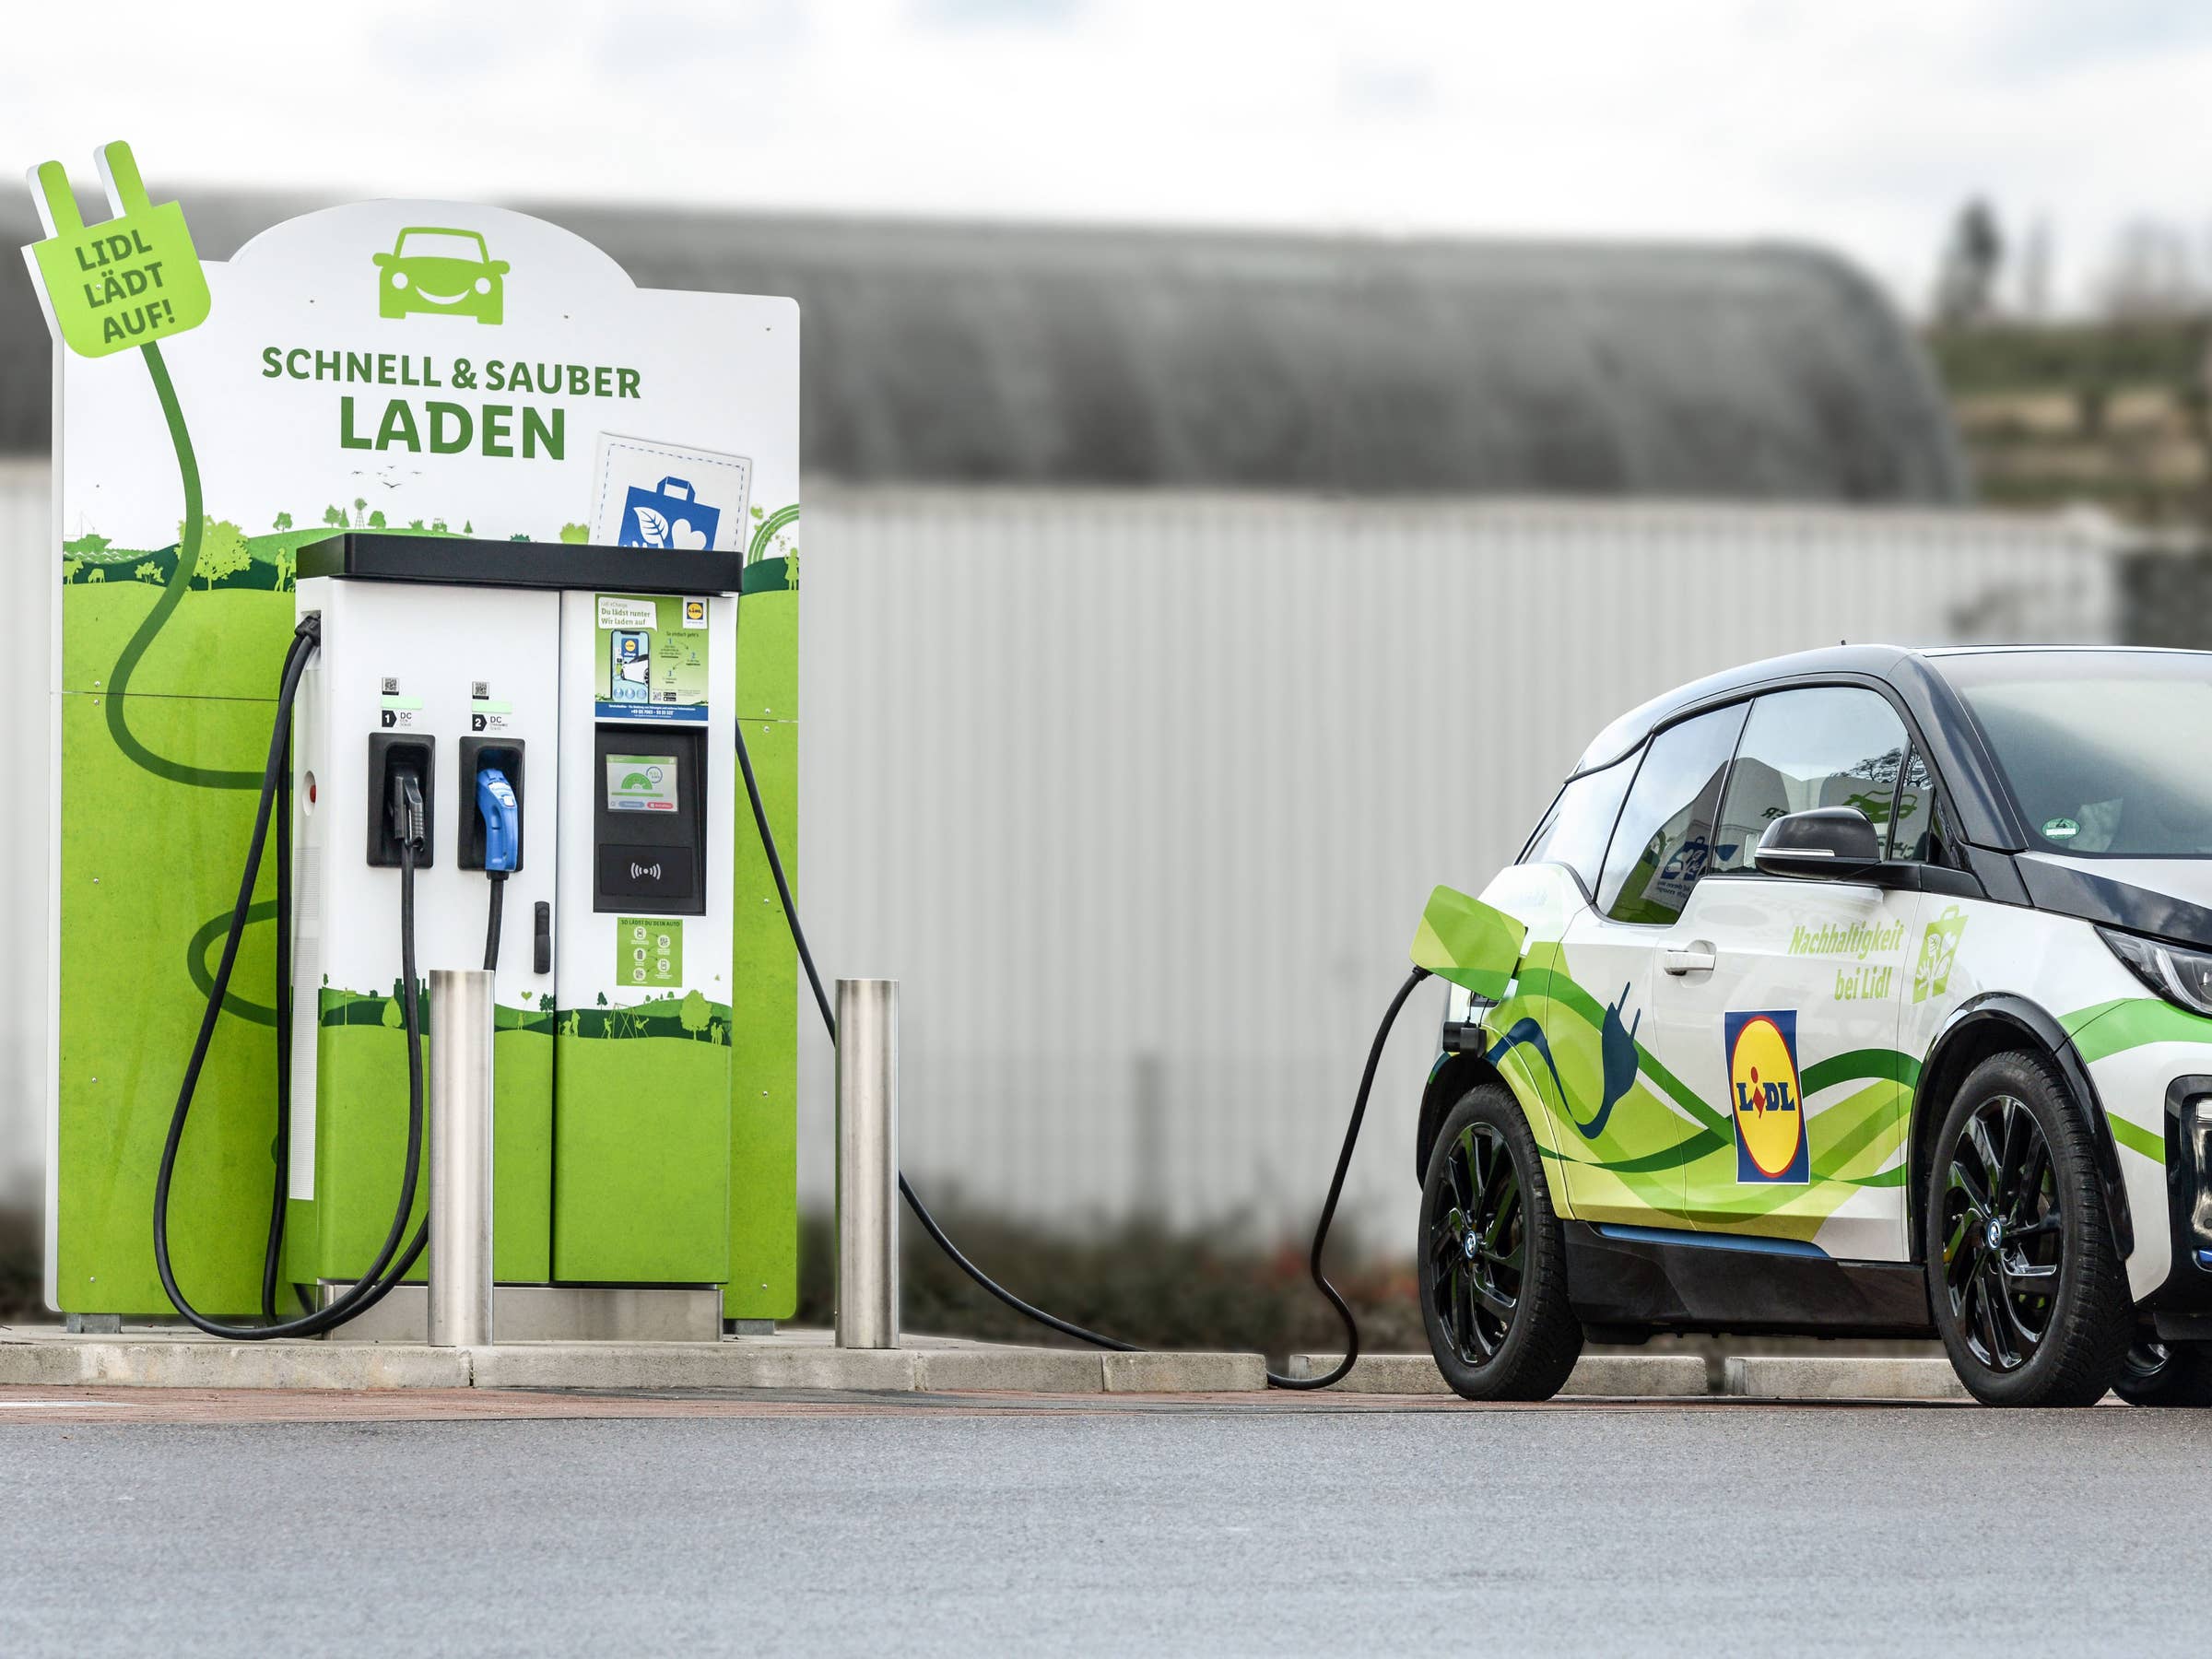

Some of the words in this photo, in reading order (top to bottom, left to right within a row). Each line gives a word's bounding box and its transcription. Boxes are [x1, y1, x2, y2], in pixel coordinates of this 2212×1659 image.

[75, 229, 153, 272] LIDL
[83, 261, 164, 309] LÄDT
[103, 299, 175, 344] AUF!
[262, 346, 442, 388] SCHNELL
[451, 357, 477, 390] &
[485, 359, 641, 399] SAUBER
[340, 395, 565, 461] LADEN
[601, 607, 611, 616] Du
[612, 608, 629, 617] lädst
[601, 617, 613, 625] Wir
[614, 618, 634, 626] laden
[384, 713, 391, 724] 1
[400, 712, 412, 720] DC
[475, 718, 482, 727] 2
[489, 715, 502, 724] DC
[1788, 919, 1904, 960] Nachhaltigkeit
[1834, 967, 1861, 1000] bei
[1861, 966, 1893, 1000] Lidl
